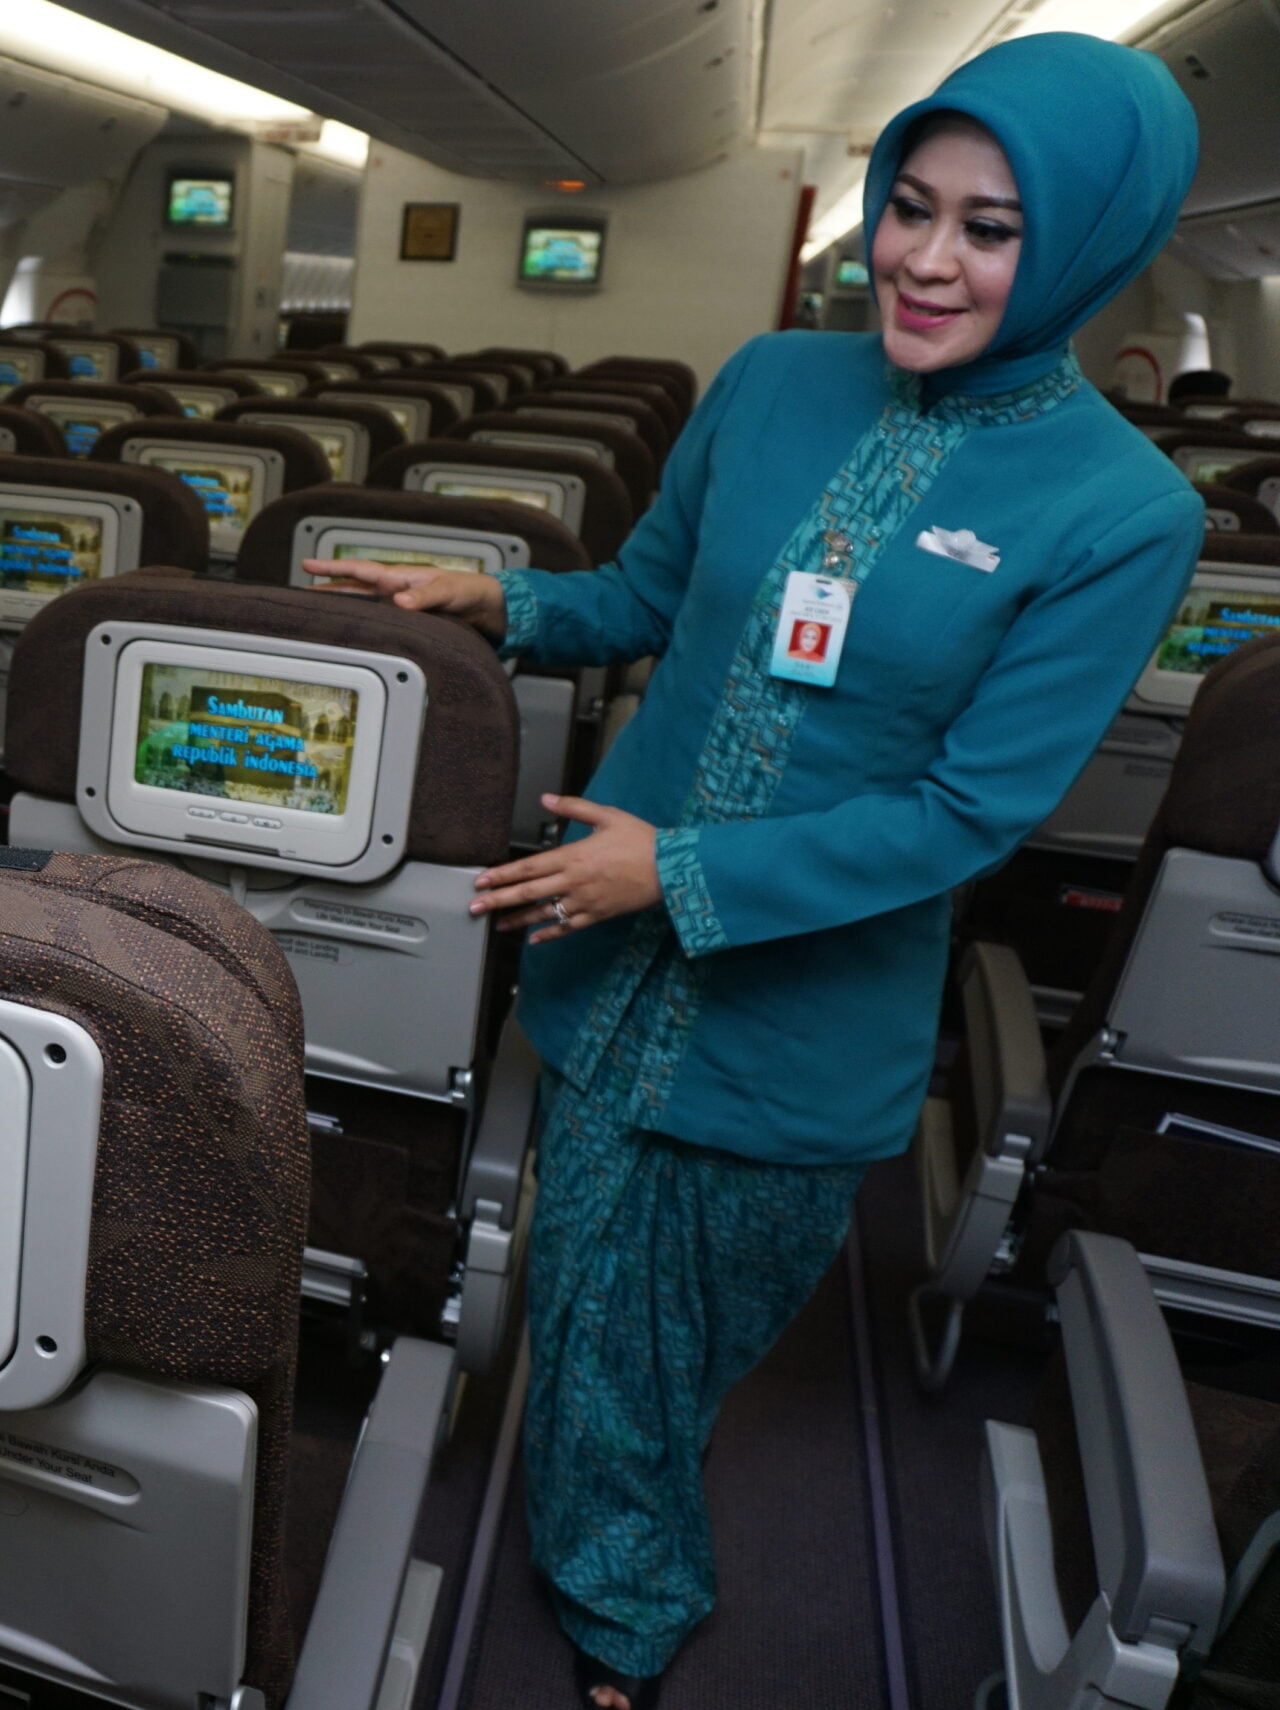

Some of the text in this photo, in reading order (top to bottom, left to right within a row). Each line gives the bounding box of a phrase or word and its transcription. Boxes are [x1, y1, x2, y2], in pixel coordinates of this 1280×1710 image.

[254, 733, 304, 752] AGAMA
[36, 1457, 62, 1473] Your
[66, 1467, 93, 1484] Seat
